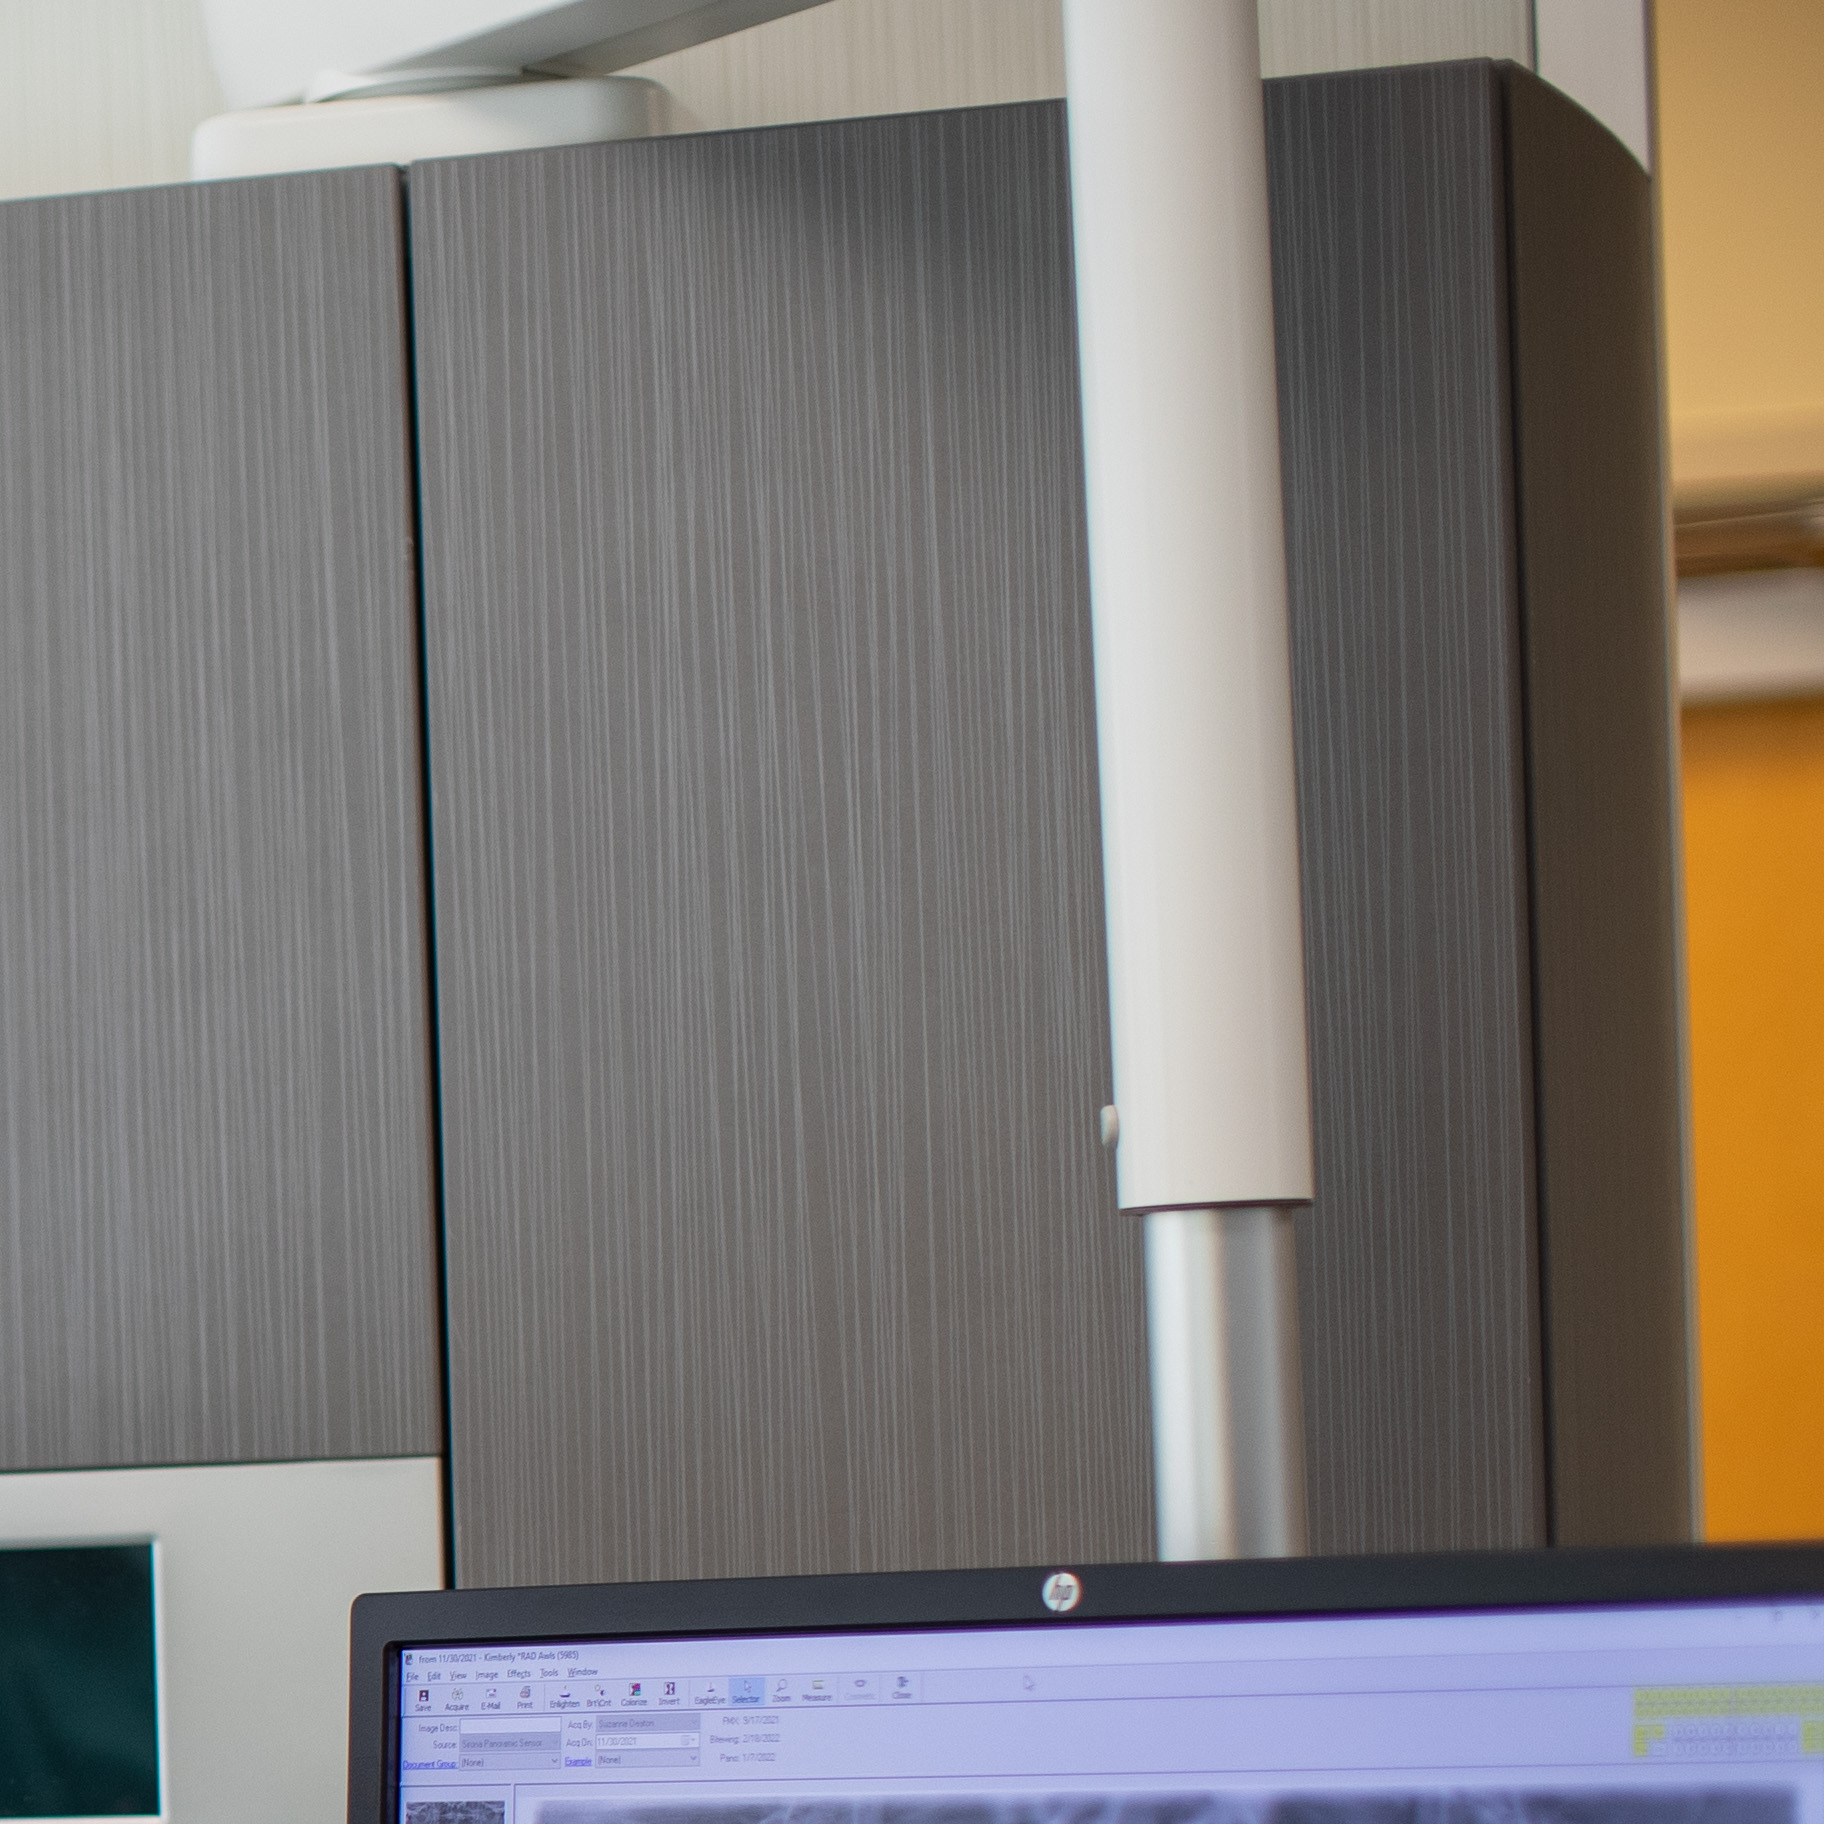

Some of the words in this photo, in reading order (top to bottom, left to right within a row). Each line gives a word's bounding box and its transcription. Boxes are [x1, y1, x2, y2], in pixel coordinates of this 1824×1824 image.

[419, 1655, 437, 1664] from
[406, 1672, 419, 1683] File
[427, 1671, 441, 1682] Edit
[450, 1671, 467, 1681] View
[475, 1670, 499, 1680] Image
[507, 1669, 531, 1679] Effects
[540, 1668, 559, 1678] Tools
[567, 1667, 598, 1678] Window
[658, 1697, 680, 1706] Invert
[732, 1695, 760, 1704] Selector
[772, 1694, 791, 1702] Zoom
[802, 1693, 832, 1702] Measure
[415, 1704, 431, 1712] Save
[445, 1703, 469, 1712] Acquire
[517, 1701, 533, 1709] Print
[550, 1700, 580, 1710] Enlighten
[419, 1724, 439, 1734] Image
[403, 1760, 435, 1770] Document
